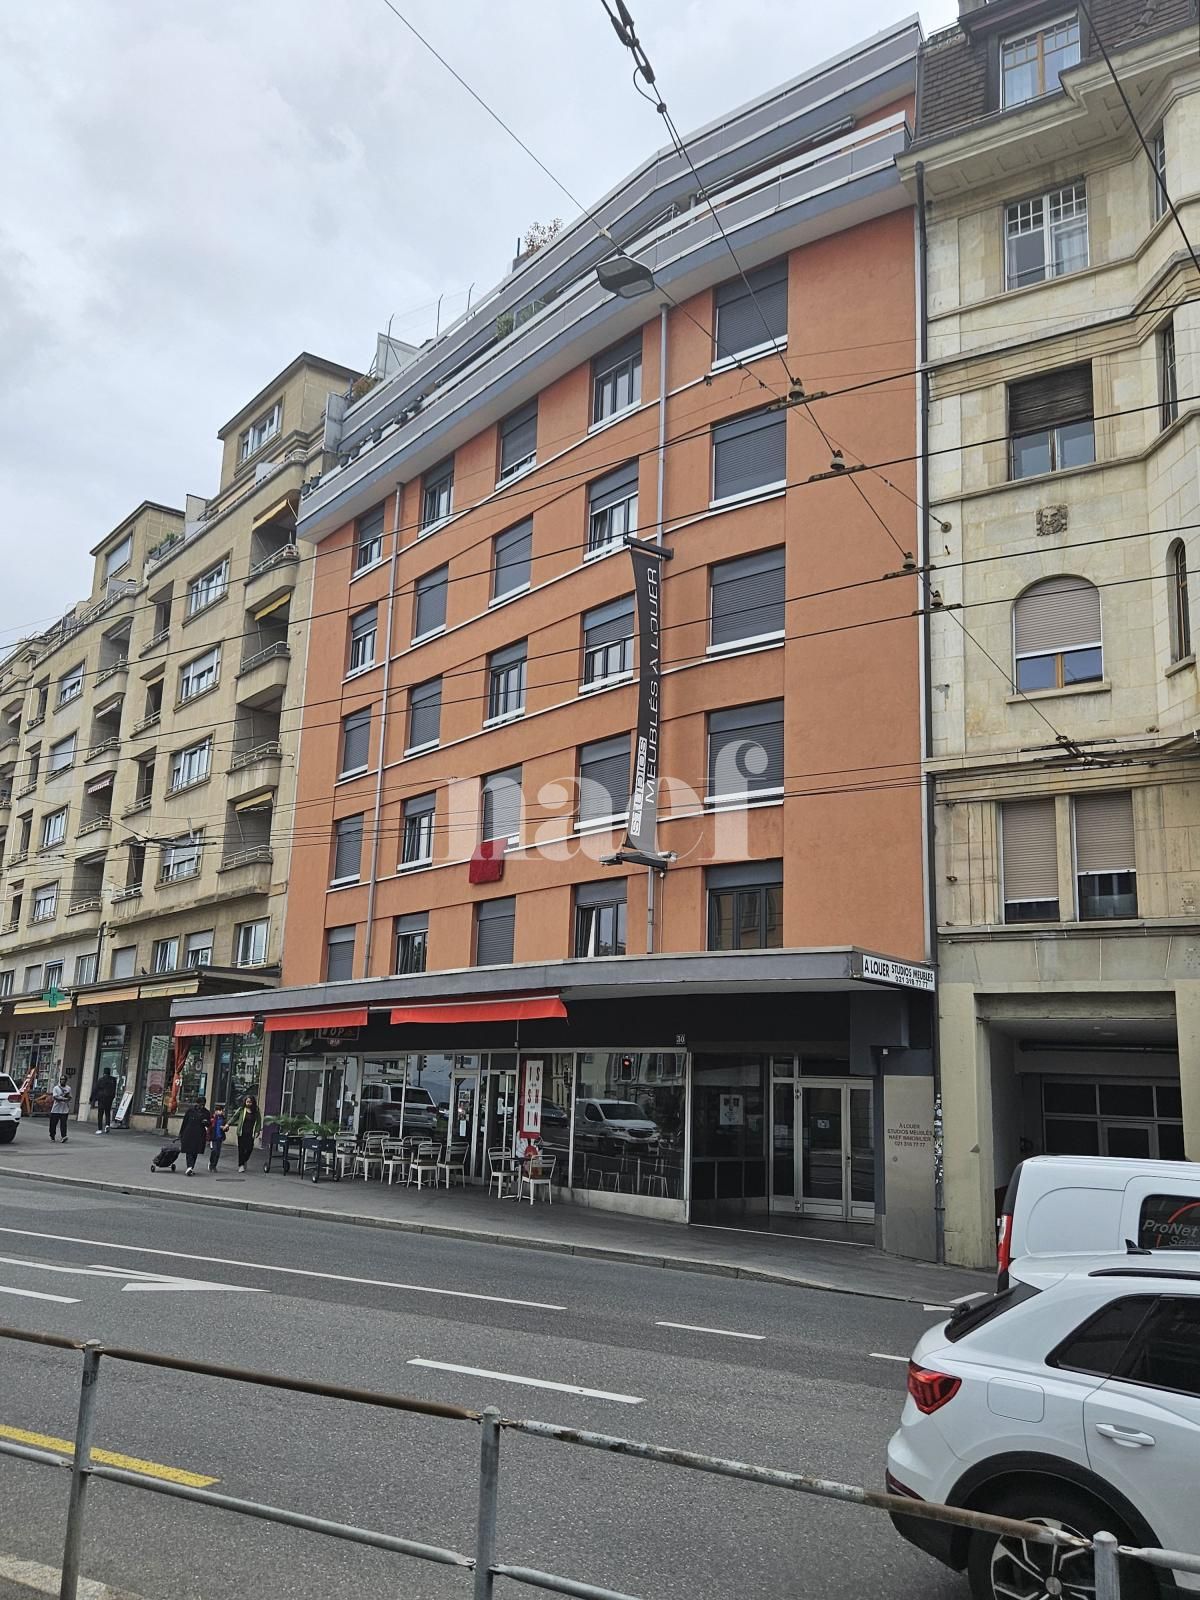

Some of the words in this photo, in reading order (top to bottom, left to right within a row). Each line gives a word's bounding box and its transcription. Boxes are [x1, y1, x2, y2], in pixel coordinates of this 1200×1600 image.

[647, 567, 659, 650] LOUER
[645, 680, 659, 803] MEUBLÉS
[631, 739, 647, 836] STUDIOS
[864, 958, 869, 973] A
[870, 960, 890, 978] LOUER
[891, 964, 912, 978] STUDIOS
[913, 970, 933, 983] MEUBLES
[1142, 1219, 1199, 1237] ProNet
